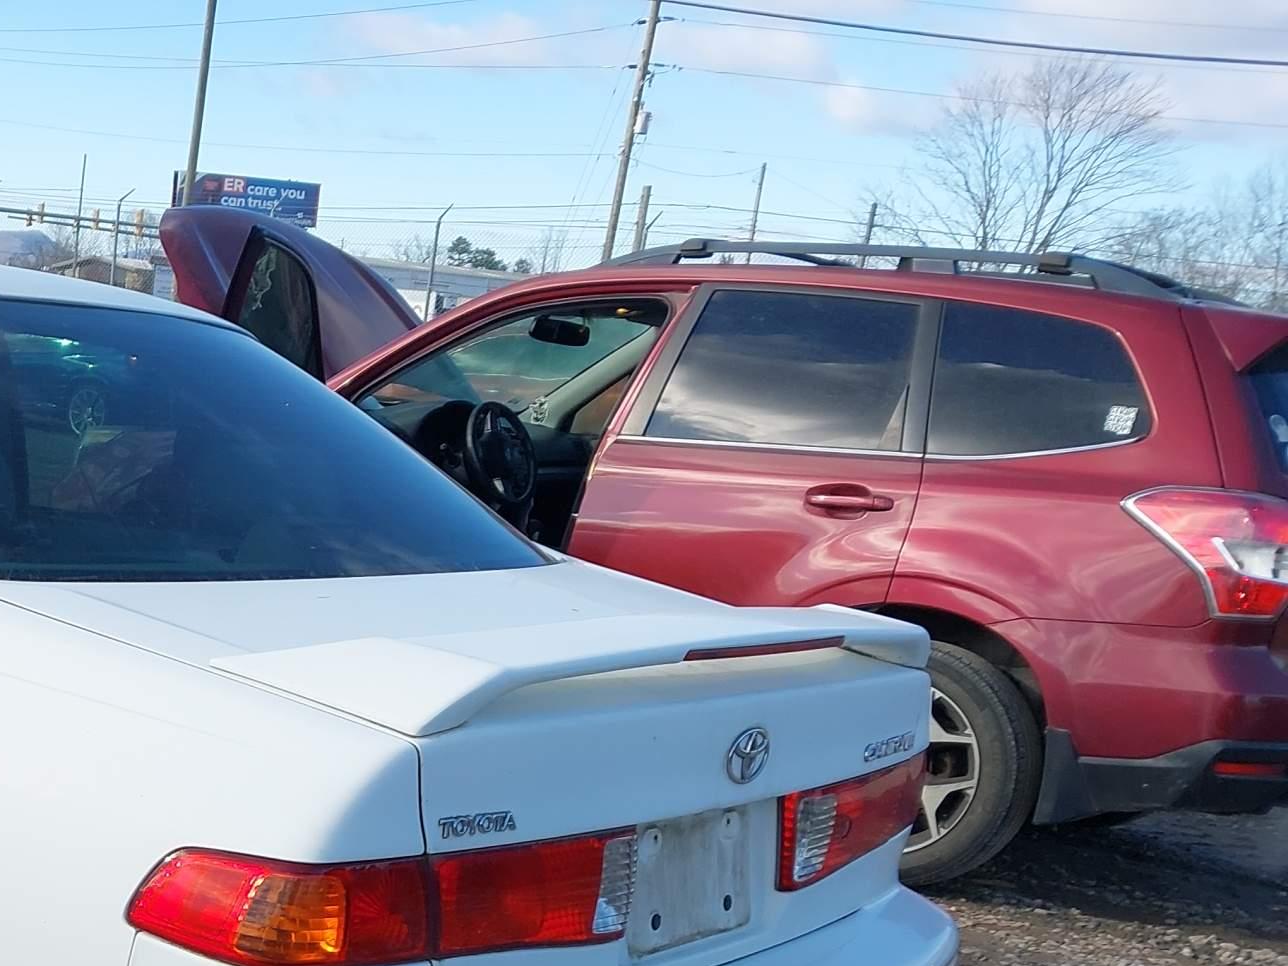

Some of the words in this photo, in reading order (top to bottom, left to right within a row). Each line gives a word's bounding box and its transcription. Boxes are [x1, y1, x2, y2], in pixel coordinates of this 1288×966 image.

[223, 177, 245, 193] ER
[247, 185, 277, 197] care
[280, 188, 306, 200] you
[220, 196, 246, 207] can
[438, 811, 516, 839] TOYOTA
